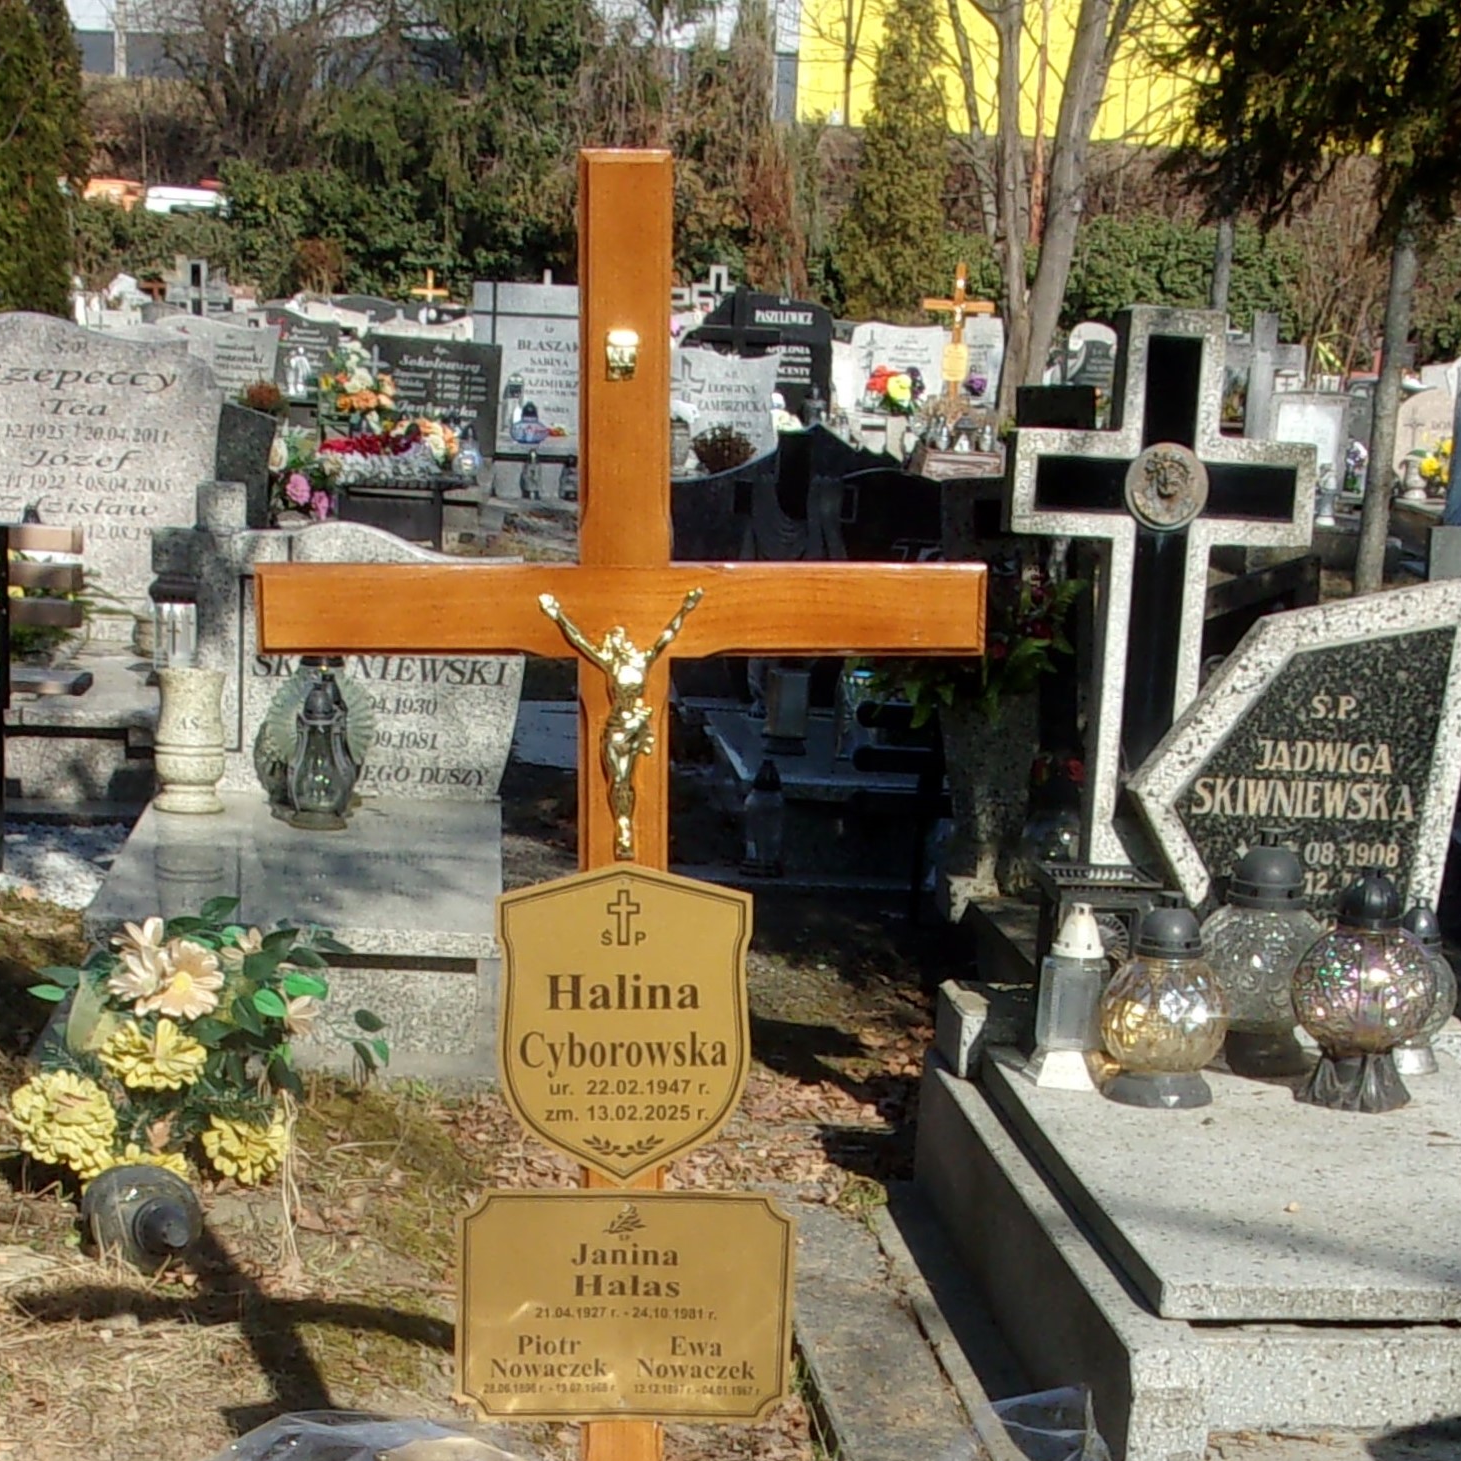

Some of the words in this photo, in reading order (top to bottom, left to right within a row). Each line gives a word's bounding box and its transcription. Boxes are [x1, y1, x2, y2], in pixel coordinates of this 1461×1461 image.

[1255, 738, 1393, 776] JADWIGA
[418, 767, 490, 786] DUSZY
[1191, 776, 1416, 822] SKIWNIEWSKA
[634, 931, 647, 946] P
[546, 974, 700, 1010] Halina
[519, 1031, 727, 1078] Cyborowska
[549, 1083, 574, 1096] ur.
[587, 1080, 691, 1096] 22.02.1947
[698, 1083, 711, 1095] r.
[545, 1108, 579, 1122] zm.
[587, 1105, 691, 1121] 13.02.2025
[697, 1108, 709, 1121] r.
[571, 1243, 679, 1267] Janina
[535, 1307, 607, 1319] 21.04.1927
[518, 1334, 582, 1356] Piotr
[670, 1336, 723, 1358] Ewa
[491, 1358, 608, 1379] Nowaczek
[637, 1358, 756, 1381] Nowaczek
